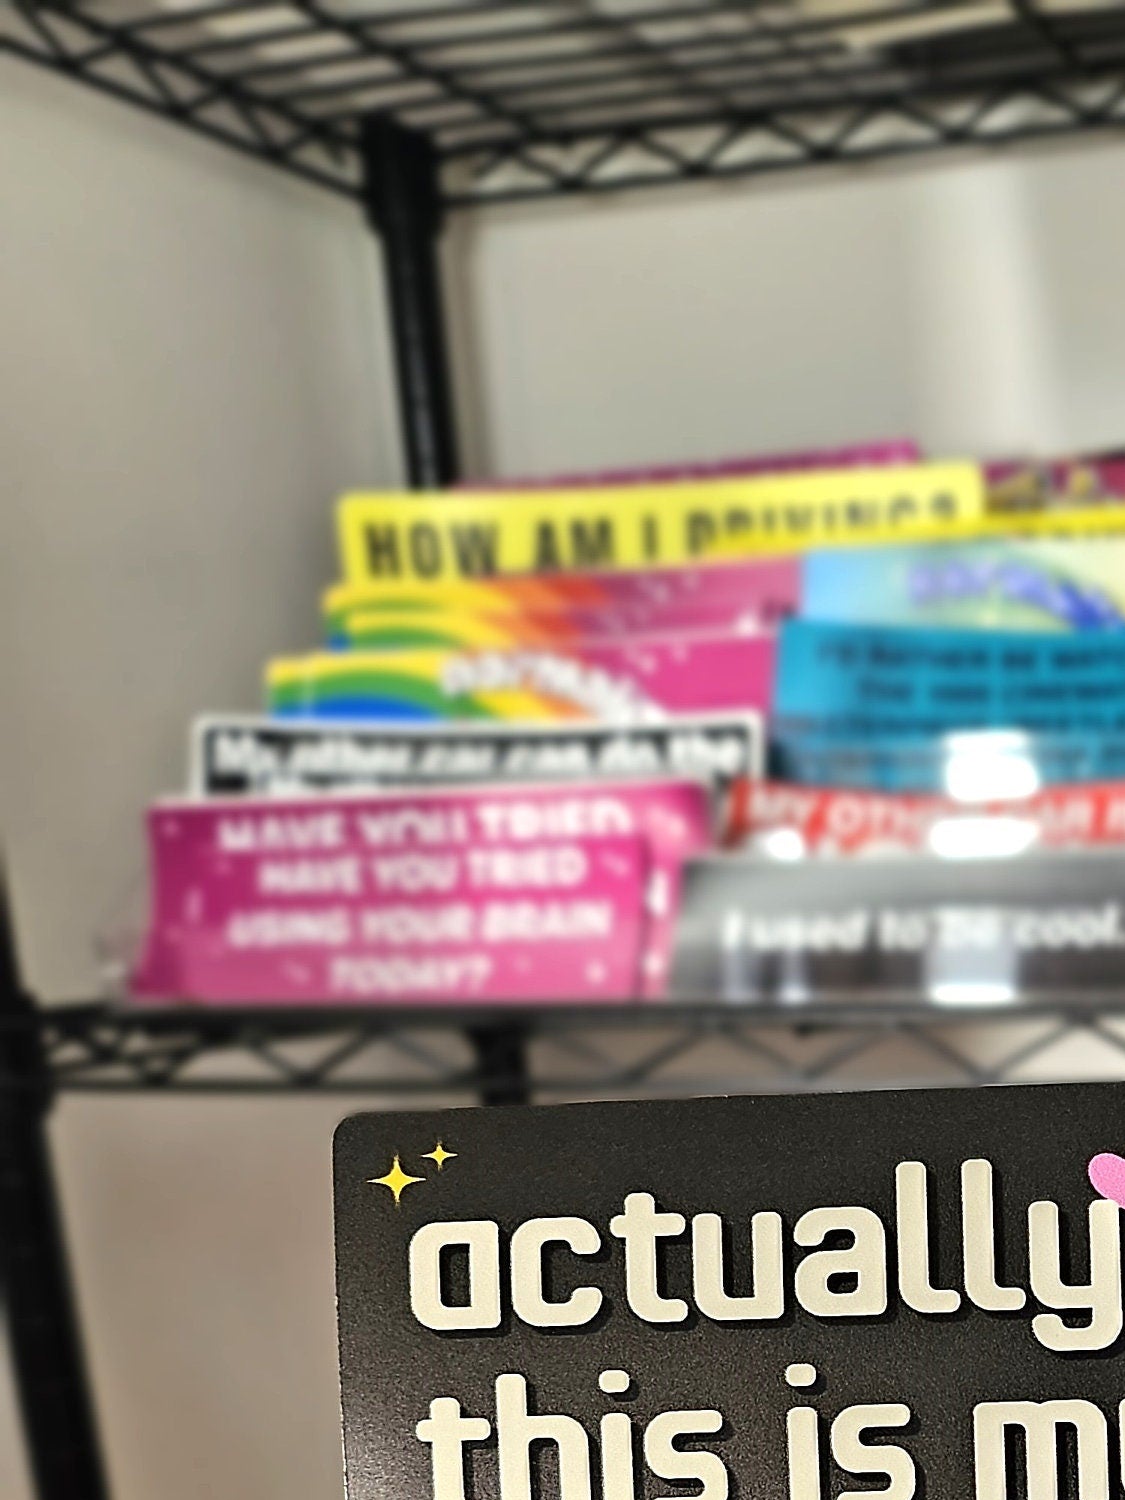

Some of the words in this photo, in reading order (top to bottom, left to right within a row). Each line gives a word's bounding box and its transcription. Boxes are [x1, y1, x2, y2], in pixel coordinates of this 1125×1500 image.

[363, 518, 502, 581] HOW
[533, 512, 617, 568] AM
[643, 511, 660, 560] I
[257, 854, 364, 894] HAVE
[370, 850, 460, 892] YOU
[466, 846, 588, 888] TRIED
[225, 907, 352, 949] USING
[361, 904, 473, 946] YOUR
[480, 899, 615, 941] BRAIN
[327, 954, 494, 996] TODAY?
